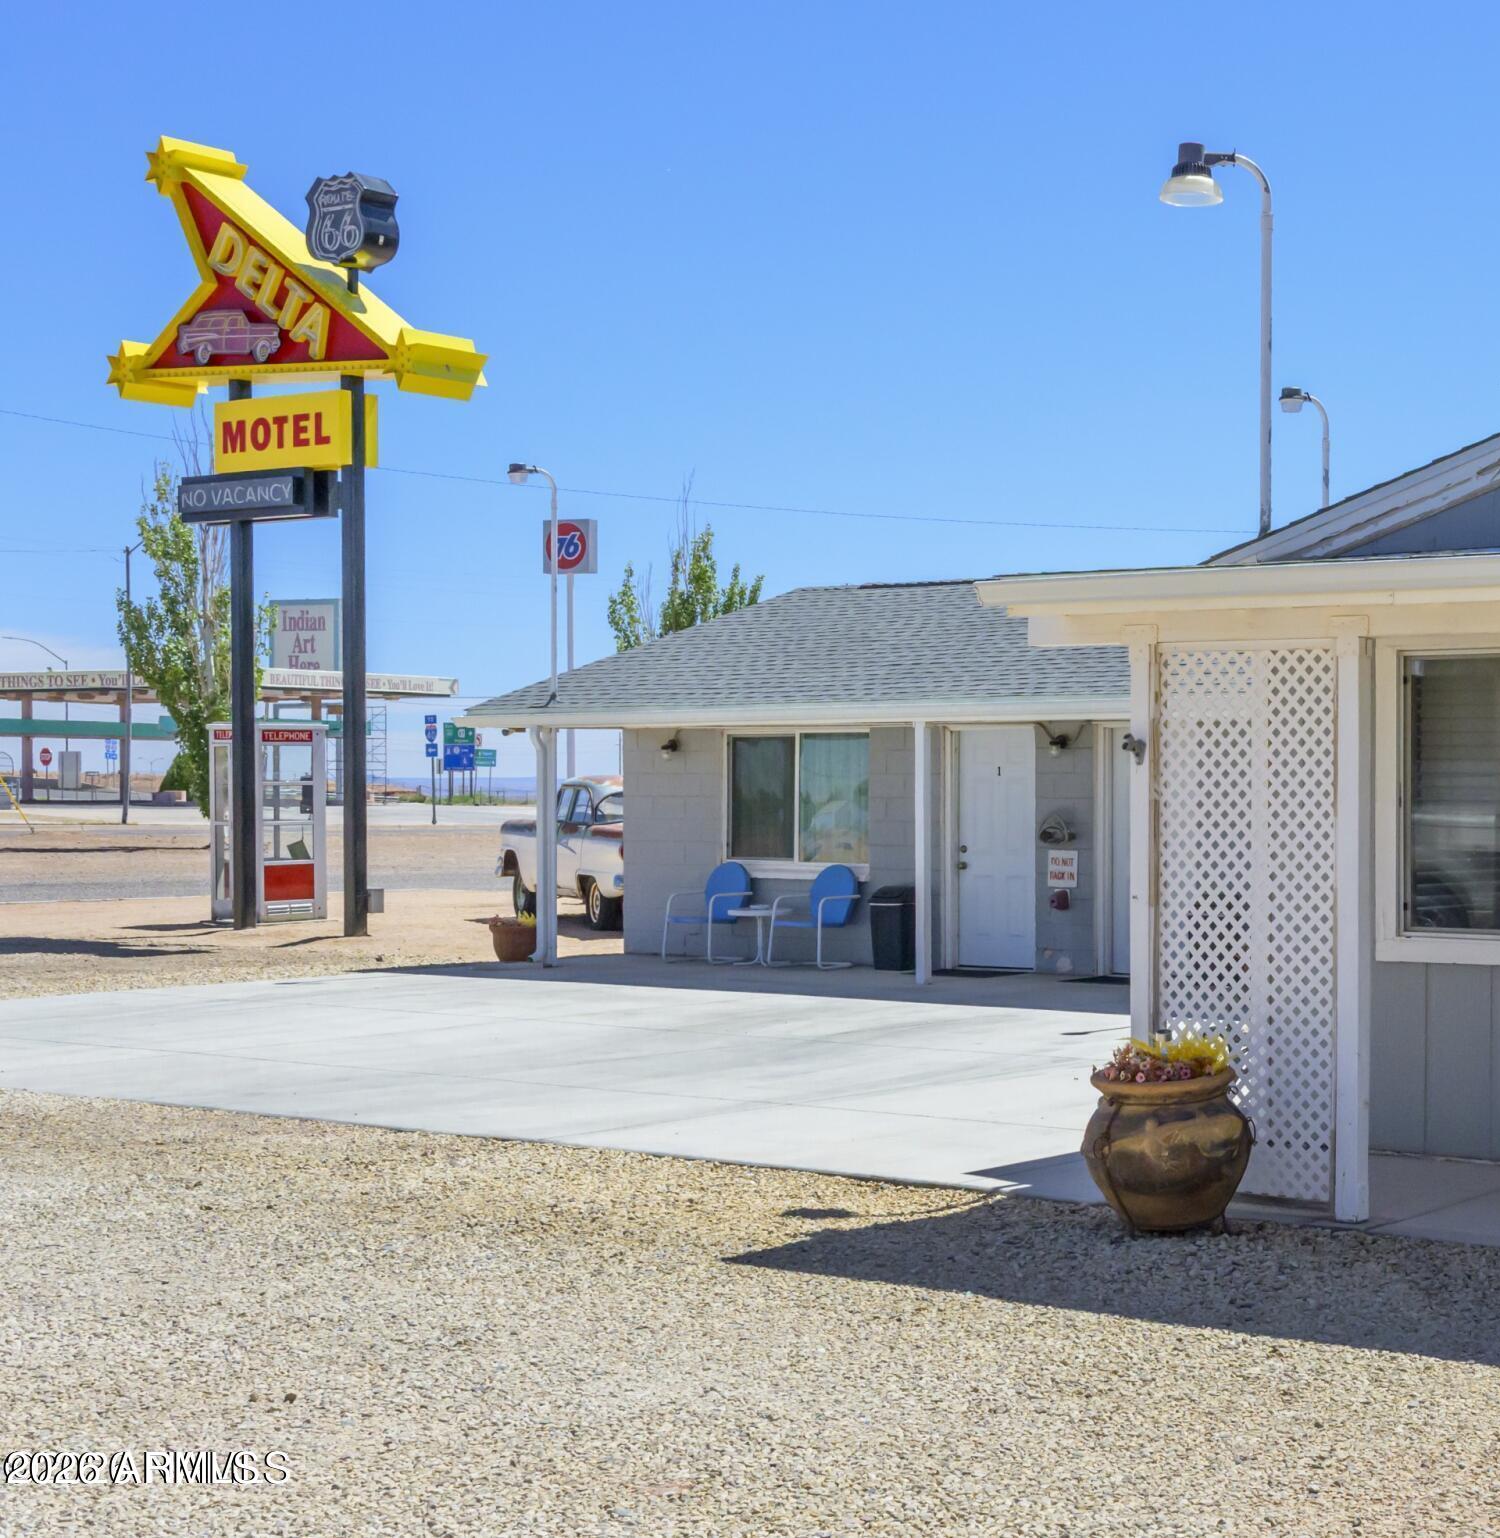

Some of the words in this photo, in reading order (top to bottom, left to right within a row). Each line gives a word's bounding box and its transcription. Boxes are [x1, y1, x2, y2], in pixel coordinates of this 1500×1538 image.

[319, 190, 354, 205] ROUTE
[321, 210, 359, 251] 66
[207, 221, 331, 361] DELTA
[222, 411, 331, 454] MOTEL
[181, 489, 207, 508] NO
[211, 483, 292, 506] VACANCY
[557, 531, 581, 560] 76
[281, 610, 327, 632] Indian
[292, 635, 317, 654] Art
[0, 675, 45, 688] THINGS
[46, 675, 63, 687] TO
[270, 672, 318, 686] BEAUTIFUL
[319, 675, 342, 688] THIN
[264, 731, 311, 741] TELEPHONE
[997, 766, 1001, 776] 1
